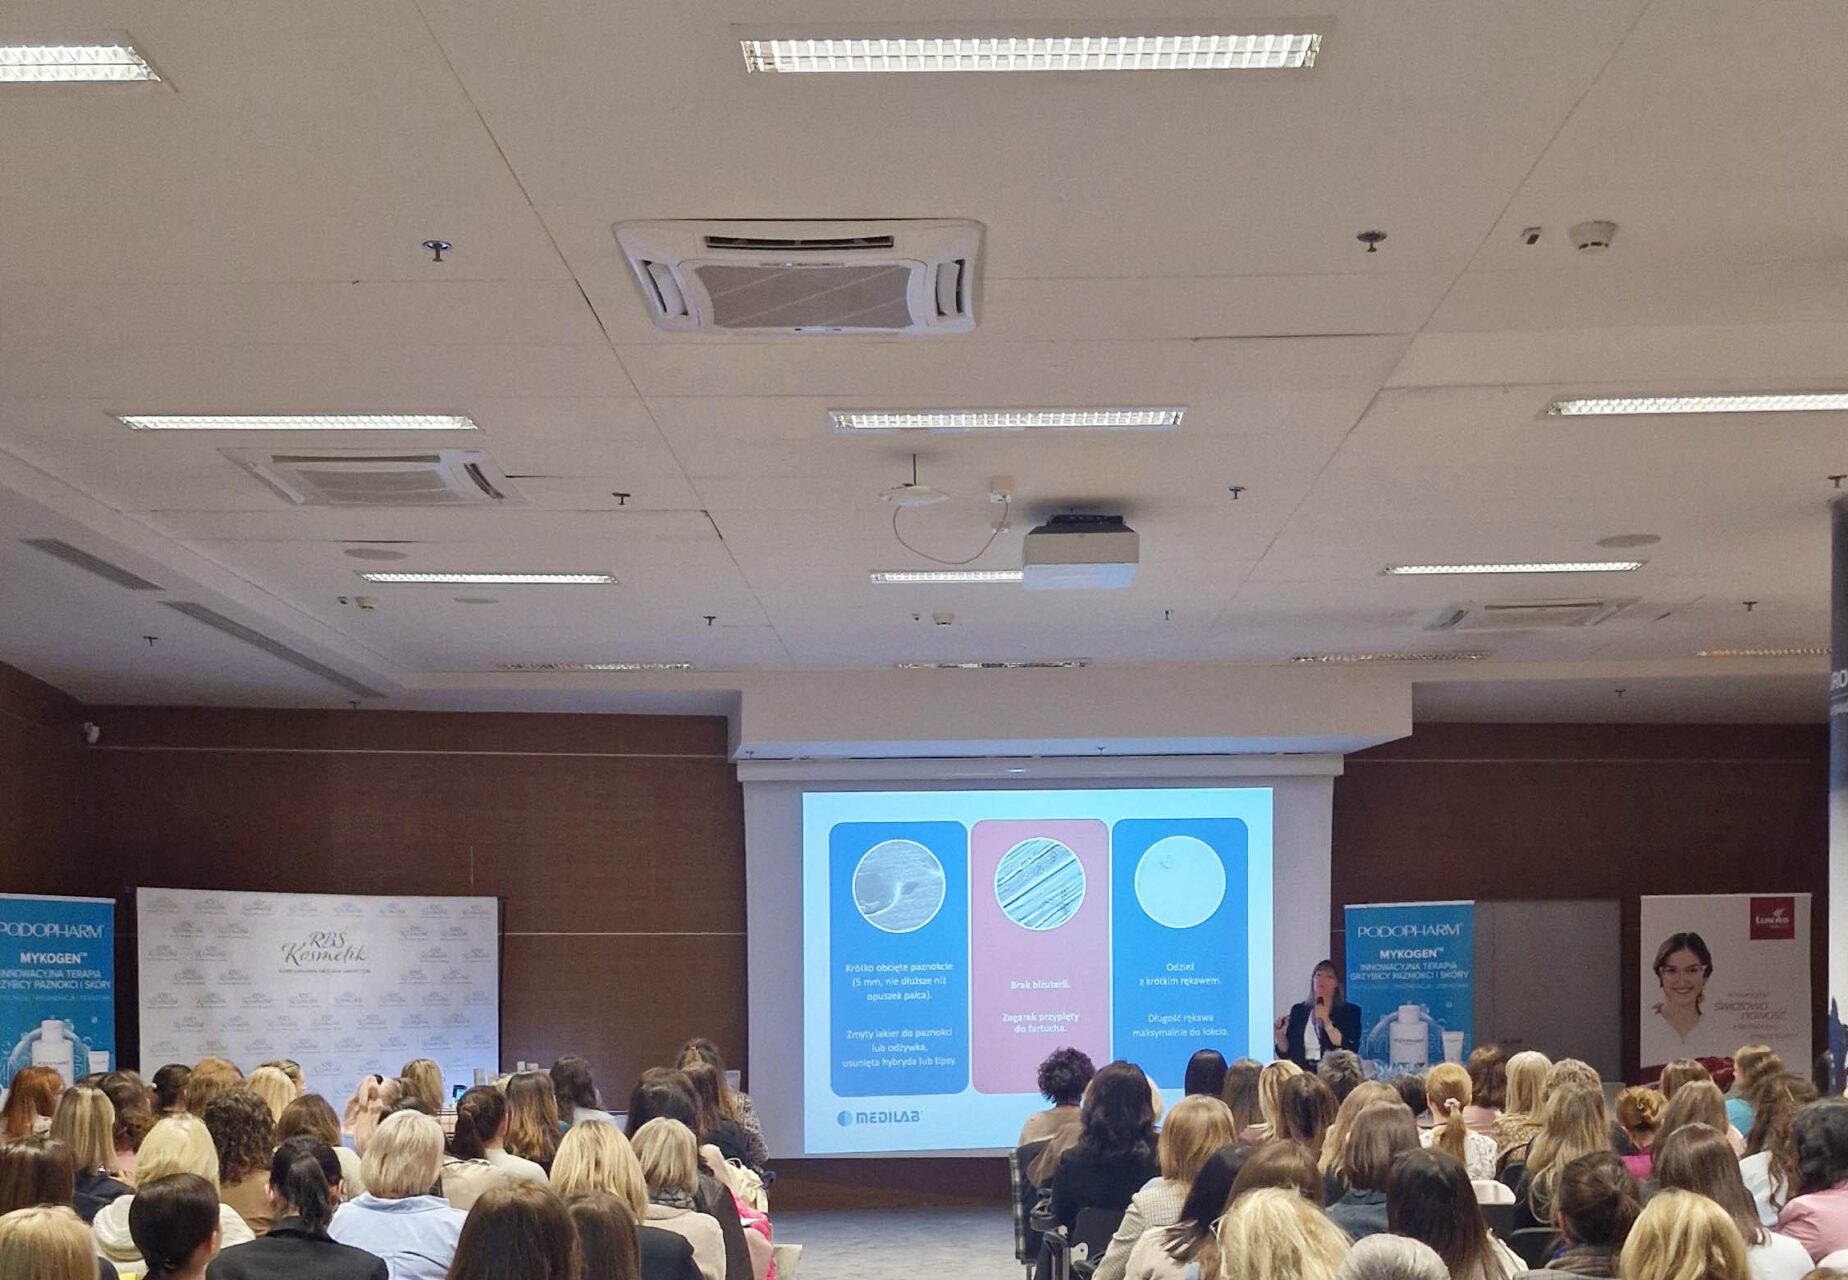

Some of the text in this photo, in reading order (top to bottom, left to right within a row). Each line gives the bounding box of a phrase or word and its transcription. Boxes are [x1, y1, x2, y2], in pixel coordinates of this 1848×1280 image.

[308, 931, 347, 949] RBS
[281, 942, 367, 967] Kosmetik
[910, 962, 953, 973] paznokcie
[1423, 961, 1457, 970] TERAPIA
[66, 969, 102, 979] TERAPIA
[885, 977, 899, 986] nie
[1010, 980, 1031, 989] Brak
[1146, 977, 1179, 986] krótkim
[867, 991, 902, 1002] opuszek
[1002, 1013, 1037, 1023] Zegarek
[1184, 1014, 1214, 1024] rękawa
[846, 1028, 953, 1040] Zmyty lakier do paznokci
[1014, 1025, 1026, 1033] do
[1132, 1028, 1187, 1038] maksymalnie
[1189, 1028, 1201, 1036] do
[872, 1043, 886, 1053] lub
[882, 1057, 917, 1068] hybryda
[919, 1056, 933, 1066] lub
[855, 1110, 921, 1124] MEDILAB
